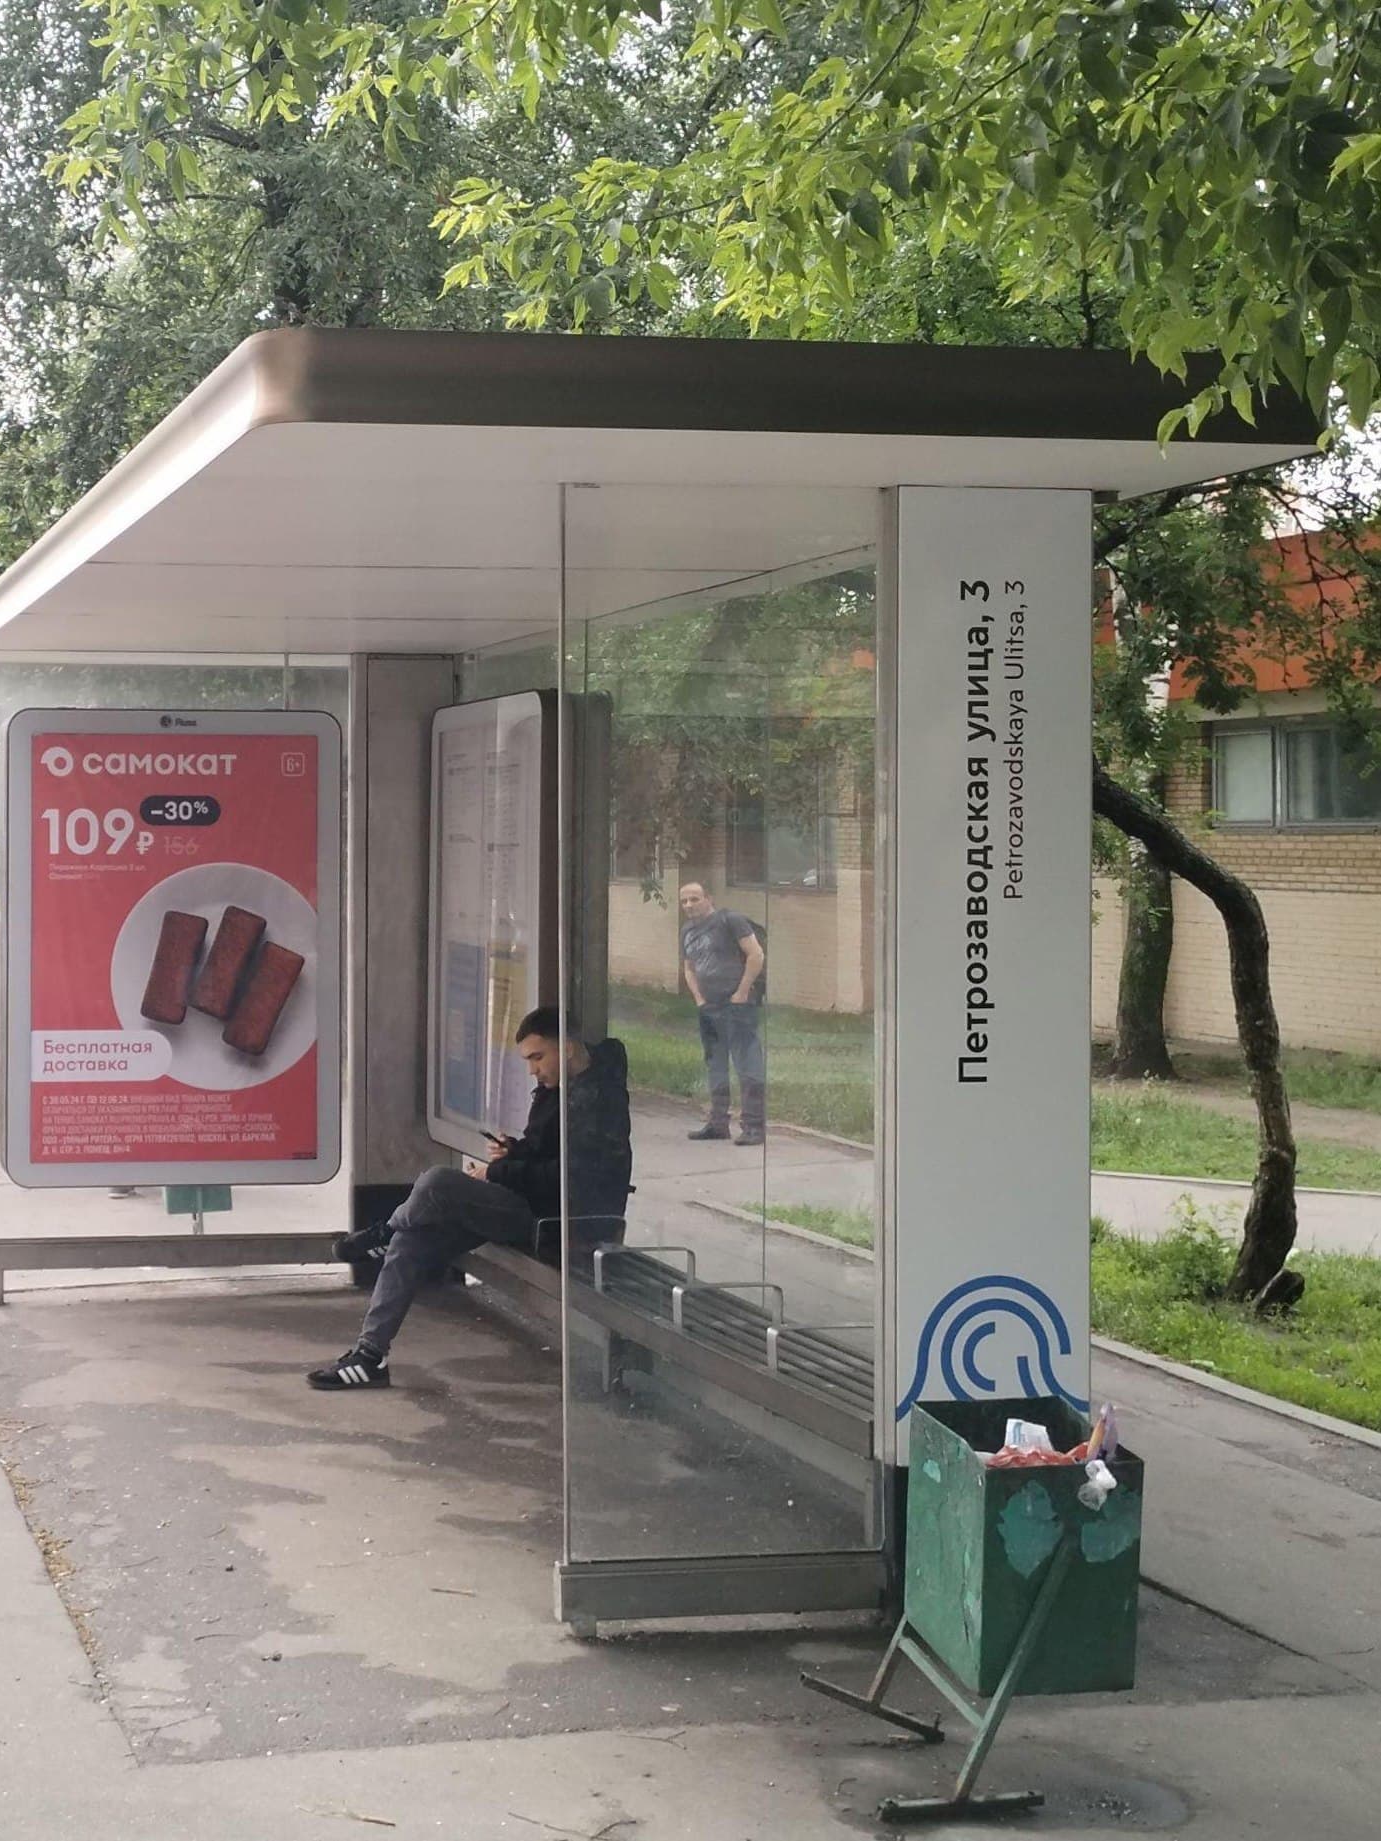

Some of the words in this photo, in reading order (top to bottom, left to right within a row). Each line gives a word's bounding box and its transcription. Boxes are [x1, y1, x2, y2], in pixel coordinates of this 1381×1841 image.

[960, 580, 990, 602] 3
[1005, 580, 1025, 595] 3
[1003, 604, 1028, 680] Ulitsa,
[967, 615, 996, 742] улица,
[83, 753, 237, 776] самокат
[286, 758, 301, 771] 6+
[1003, 690, 1028, 899] Petrozavodskaya
[958, 757, 995, 1083] Петрозаводская
[43, 1040, 152, 1054] Бесплатная
[43, 1060, 128, 1073] доставка
